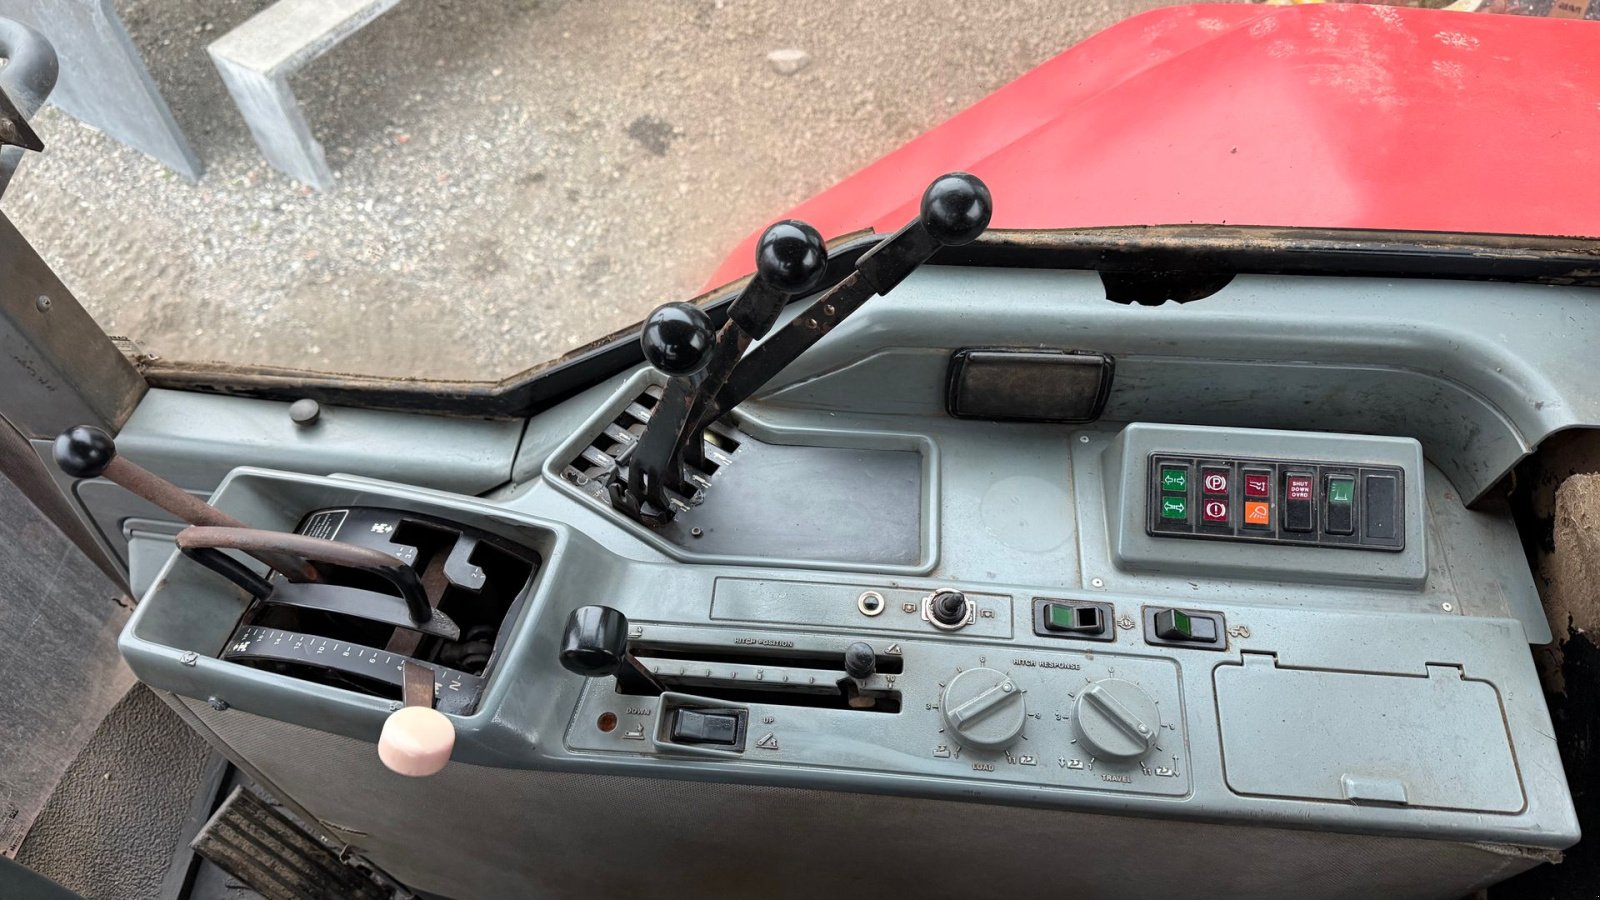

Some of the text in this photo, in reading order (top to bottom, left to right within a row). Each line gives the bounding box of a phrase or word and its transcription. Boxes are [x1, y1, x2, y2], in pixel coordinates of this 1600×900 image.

[735, 637, 794, 648] HITCH POSITION
[294, 641, 302, 649] 12
[317, 646, 325, 654] 10
[1013, 659, 1080, 670] HITCH RESPONSE
[449, 680, 462, 692] N
[626, 707, 650, 716] DOWN
[763, 716, 775, 724] UP
[972, 762, 995, 771] LOAD
[1142, 768, 1152, 776] 11
[1101, 774, 1132, 783] TRAVEL
